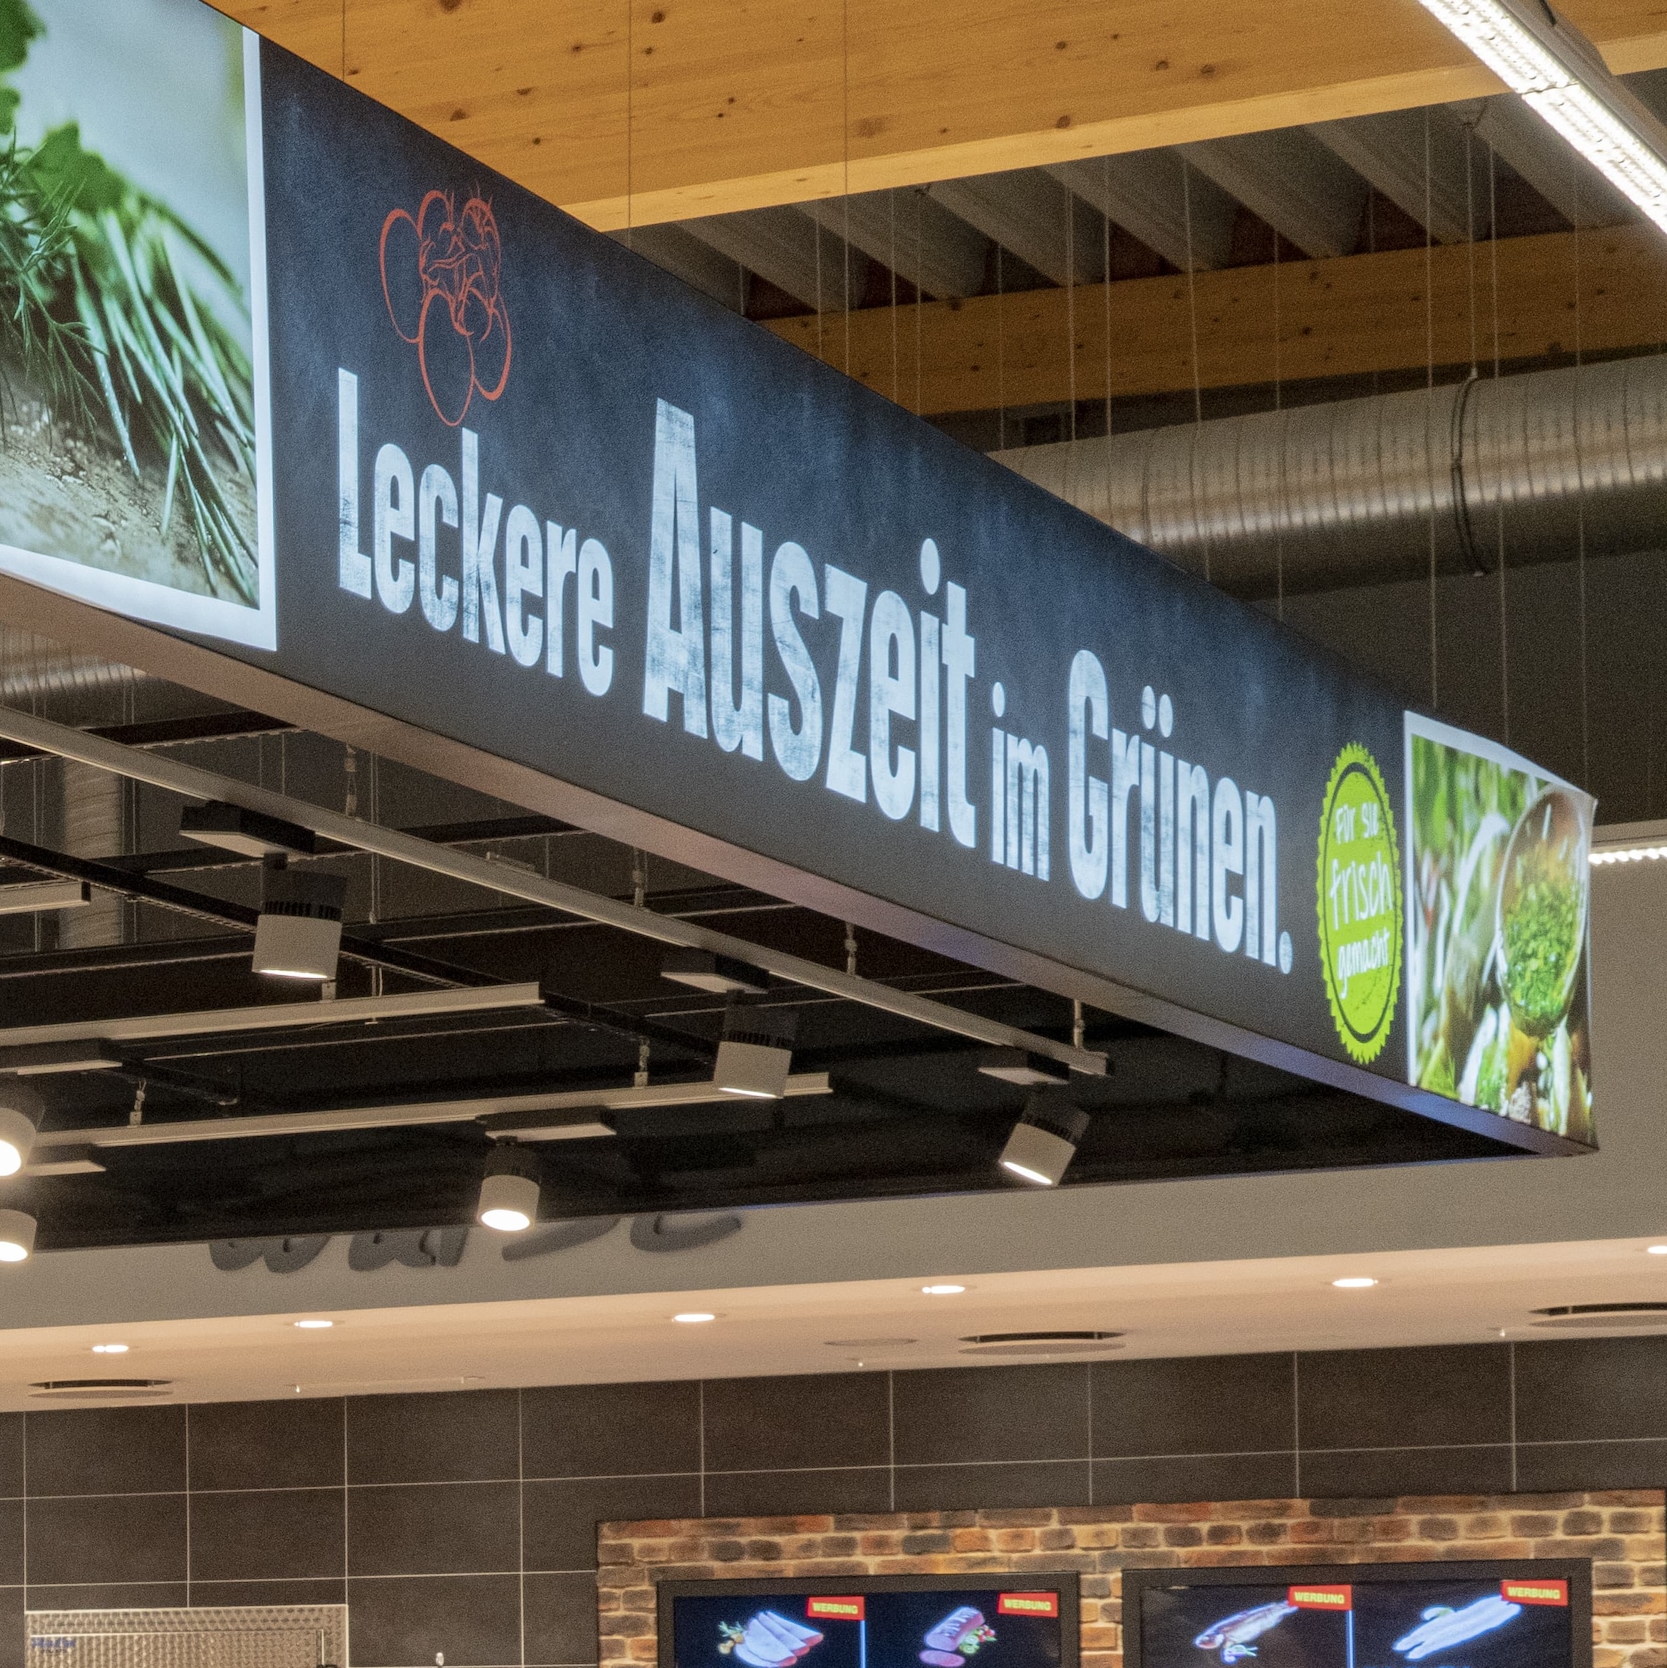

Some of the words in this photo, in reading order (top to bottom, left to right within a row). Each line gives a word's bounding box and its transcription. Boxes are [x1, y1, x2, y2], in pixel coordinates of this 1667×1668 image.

[337, 367, 614, 697] Leckere
[642, 398, 976, 849] Auszeit
[991, 681, 1050, 882] im
[1068, 649, 1293, 975] Grünen.
[1330, 850, 1394, 931] frisch
[1337, 926, 1390, 1000] gemacht
[1293, 1590, 1346, 1605] WERBUNG
[1507, 1586, 1561, 1601] WERBUNG
[812, 1602, 860, 1615] WERBUNG
[1003, 1598, 1053, 1612] WERBUNG
